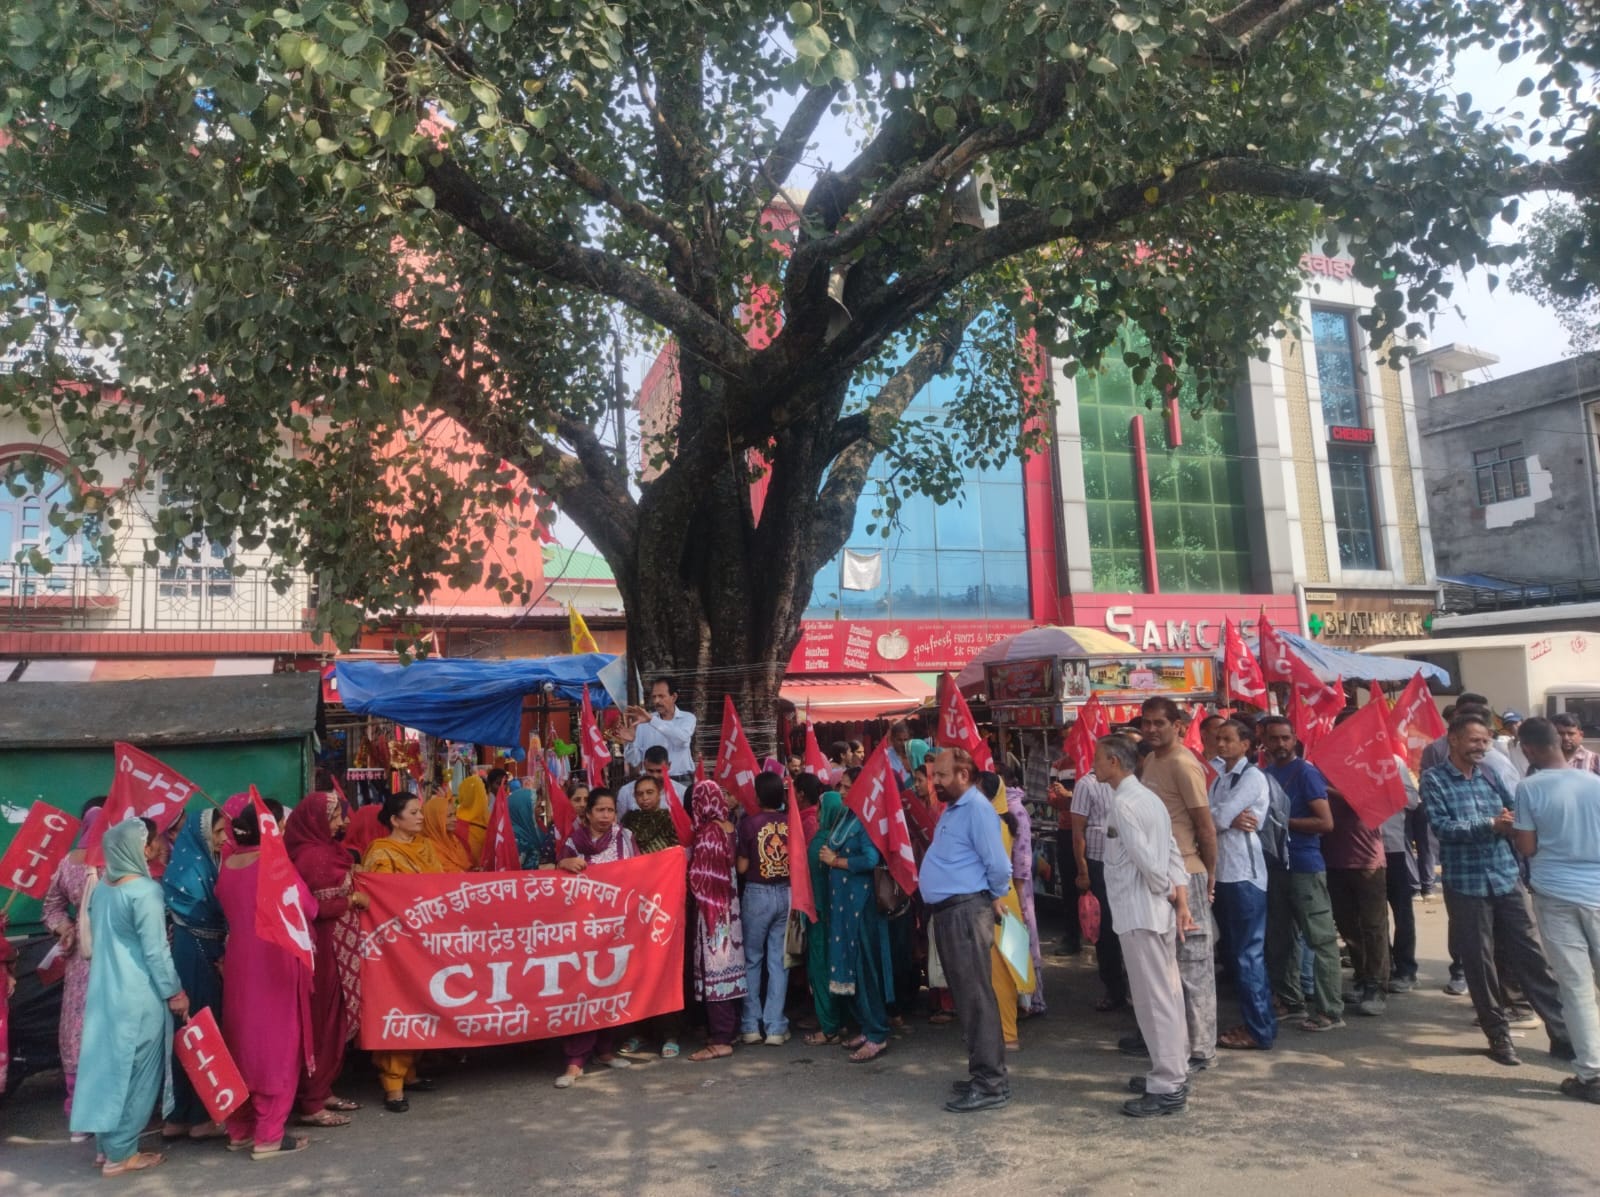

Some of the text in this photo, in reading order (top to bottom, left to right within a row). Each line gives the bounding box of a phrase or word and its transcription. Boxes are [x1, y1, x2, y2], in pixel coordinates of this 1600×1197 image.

[1332, 425, 1374, 442] CHEMIST
[1344, 731, 1387, 766] CITU
[12, 814, 68, 889] CITU
[522, 874, 557, 903] ट्रेड
[561, 873, 621, 907] यूनियन
[420, 925, 486, 958] भारतीय
[488, 922, 515, 956] ट्रेड
[517, 920, 578, 954] यूनियन
[429, 944, 635, 1008] CITU
[382, 1007, 440, 1041] जिला
[455, 1003, 530, 1037] कमेटी
[545, 991, 632, 1033] हमीरपुर
[182, 1024, 235, 1111] CITU
